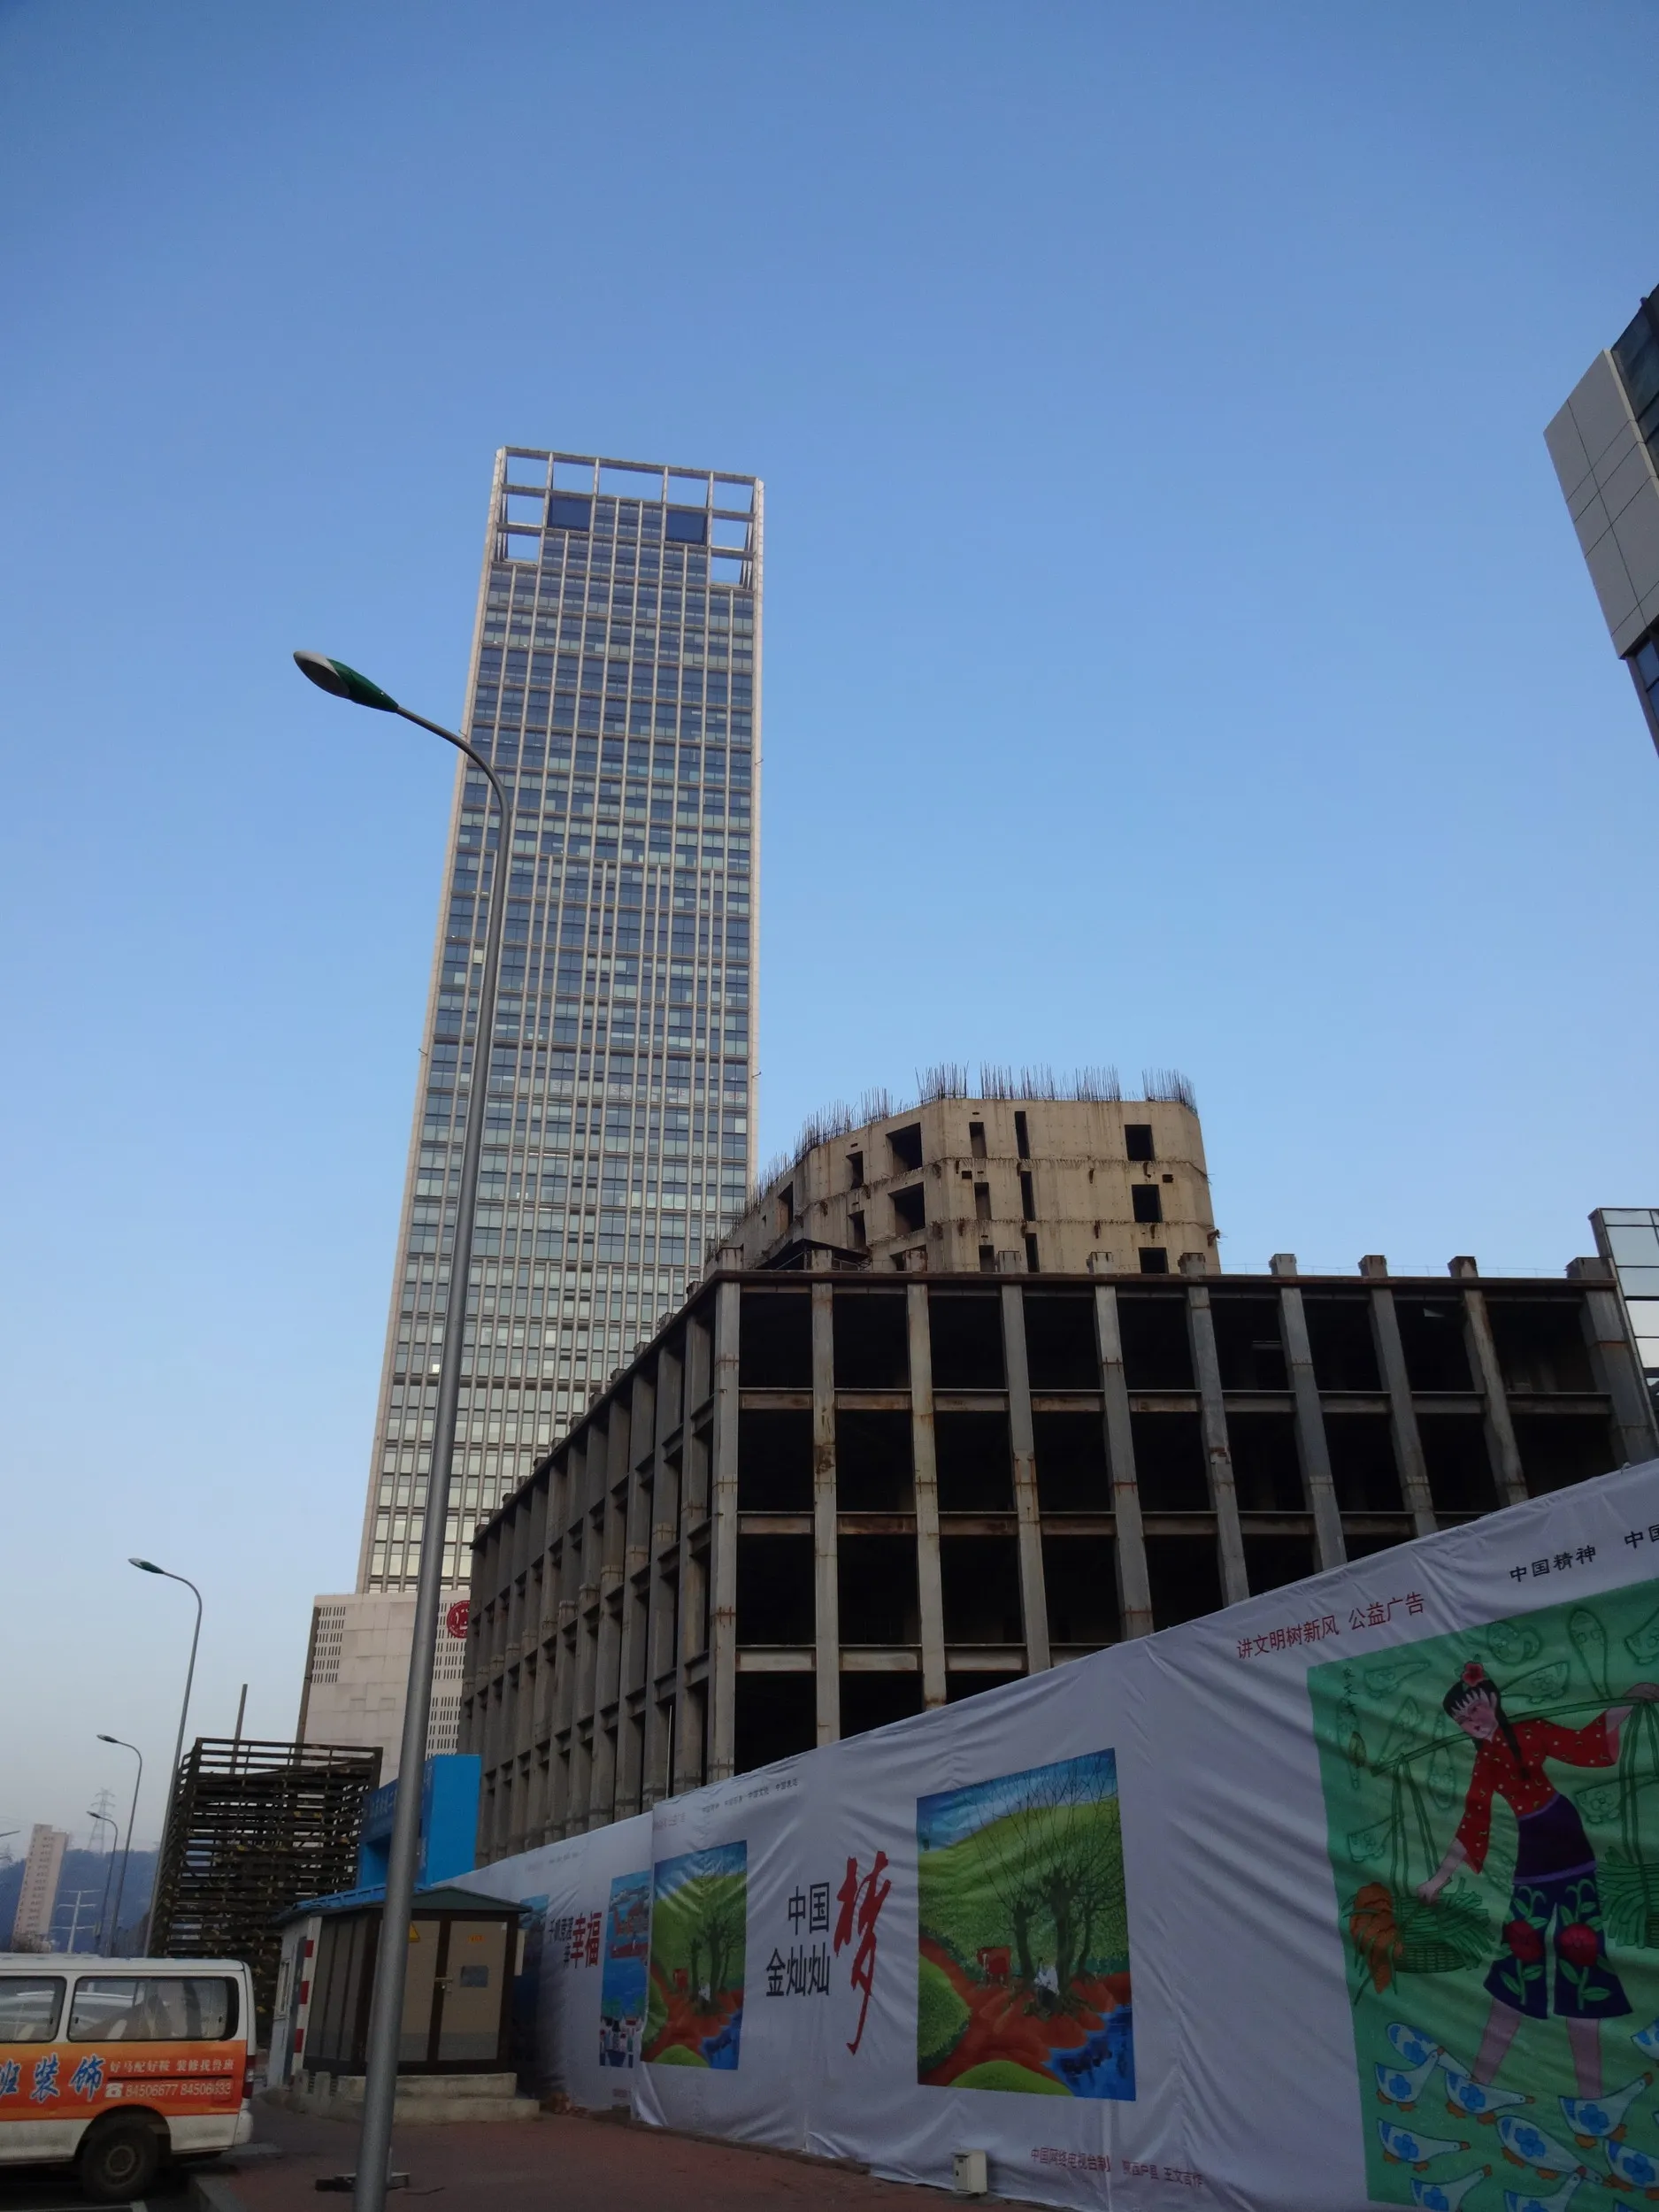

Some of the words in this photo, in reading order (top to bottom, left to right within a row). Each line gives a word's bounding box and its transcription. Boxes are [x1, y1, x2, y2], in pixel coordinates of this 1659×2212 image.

[1509, 1545, 1596, 1582] 中国精神
[1236, 1615, 1340, 1659] 讲文明树新风
[1348, 1591, 1425, 1631] 公益广告
[788, 1882, 830, 1936] 中国
[570, 1911, 603, 1969] 幸福
[833, 1850, 891, 2055] 梦
[766, 1942, 830, 1997] 金灿灿
